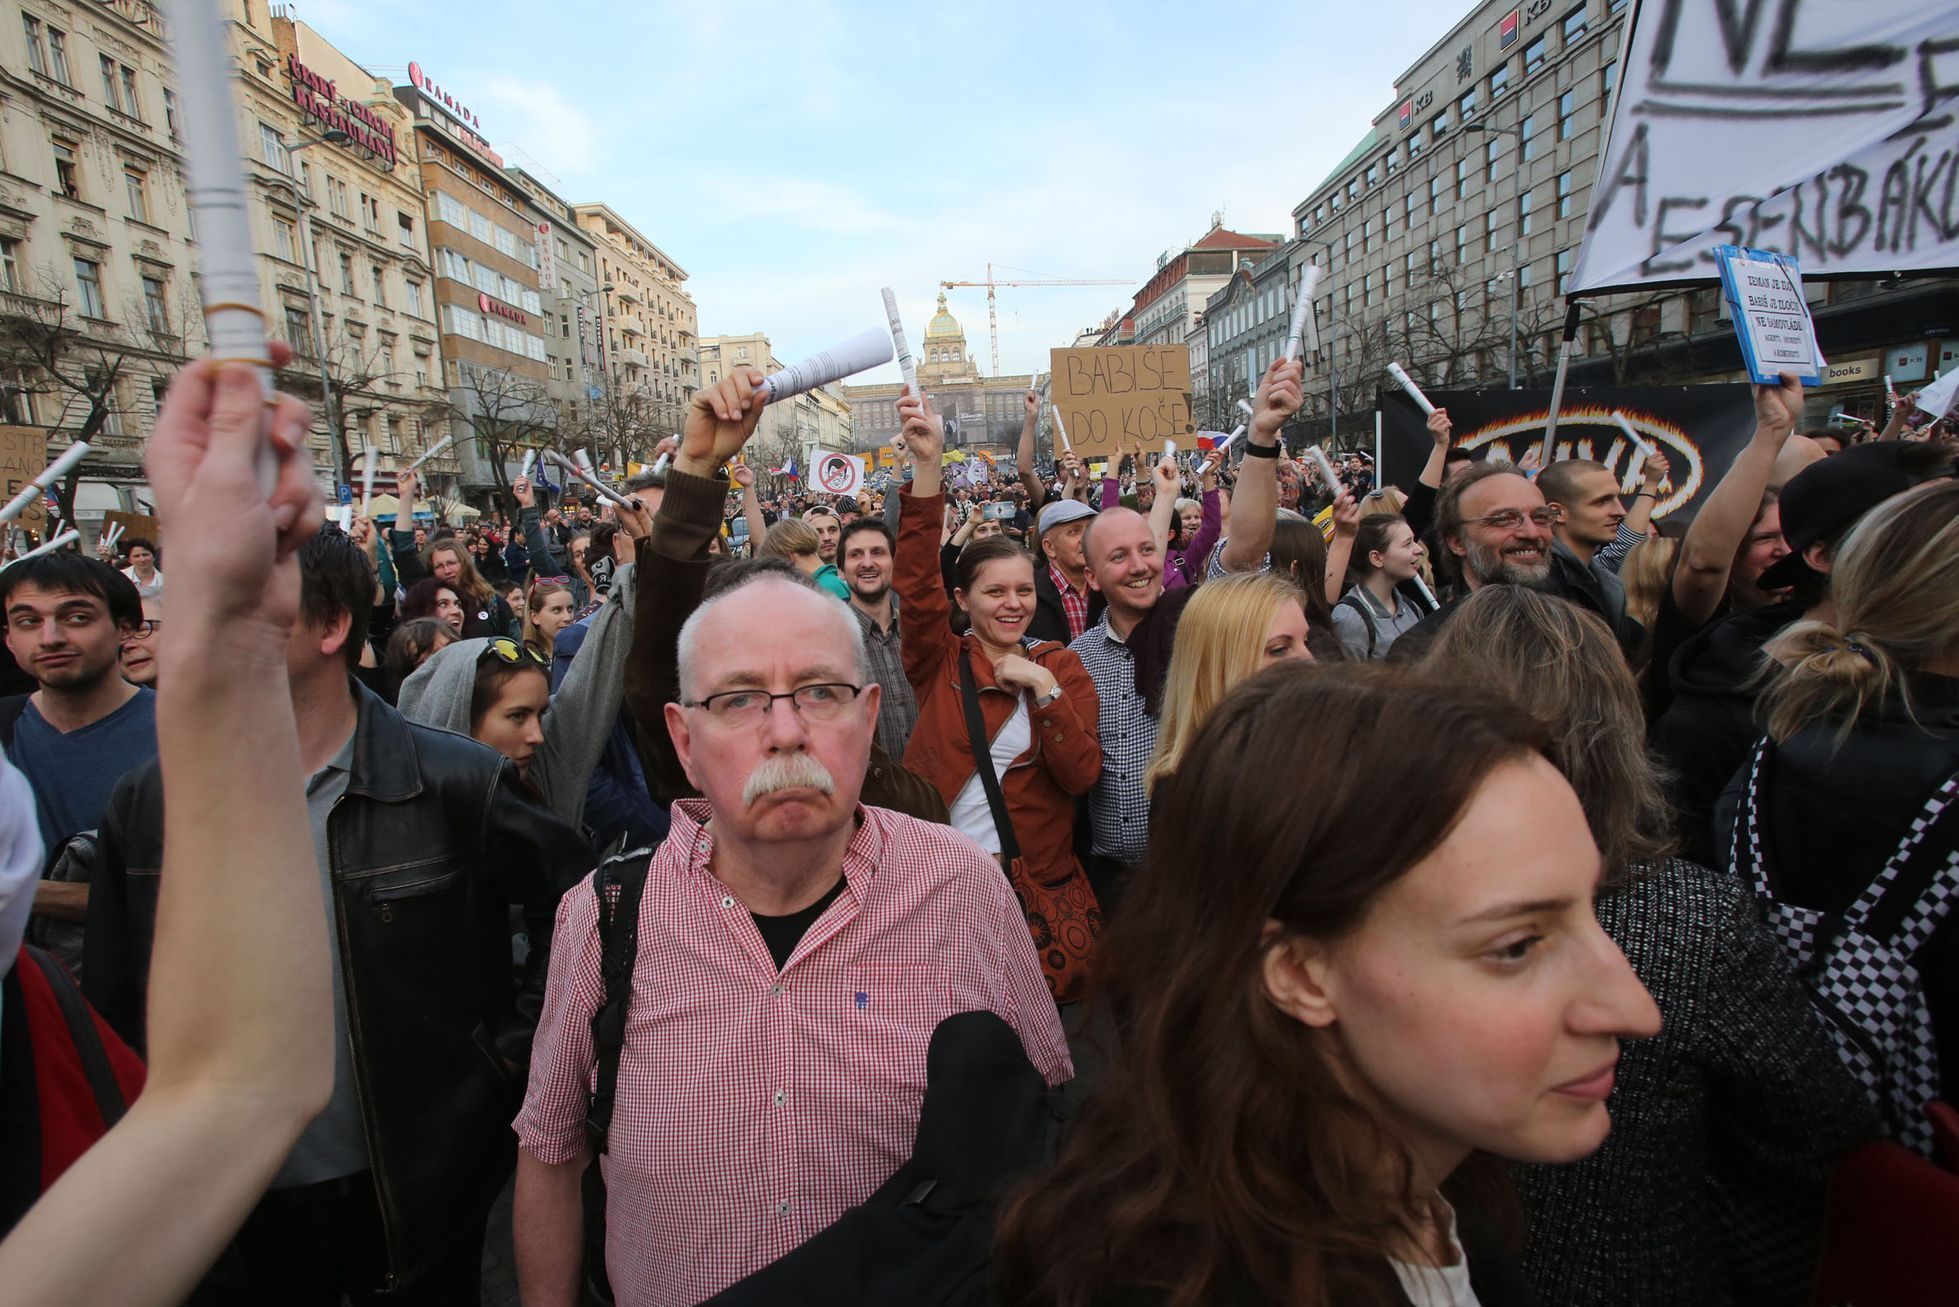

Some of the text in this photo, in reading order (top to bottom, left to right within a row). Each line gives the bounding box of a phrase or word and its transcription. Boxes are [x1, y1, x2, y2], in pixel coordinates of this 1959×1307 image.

[1524, 0, 1551, 26] KB
[1648, 0, 1907, 78] N
[292, 85, 392, 163] RESTAURANT
[425, 76, 480, 130] RAMADA
[1415, 90, 1433, 115] KB
[1587, 121, 1648, 232] A
[488, 301, 527, 326] RAMADA
[1067, 346, 1184, 396] BABIŠE
[1829, 365, 1862, 378] books
[1071, 392, 1196, 446] DO KOŠE!
